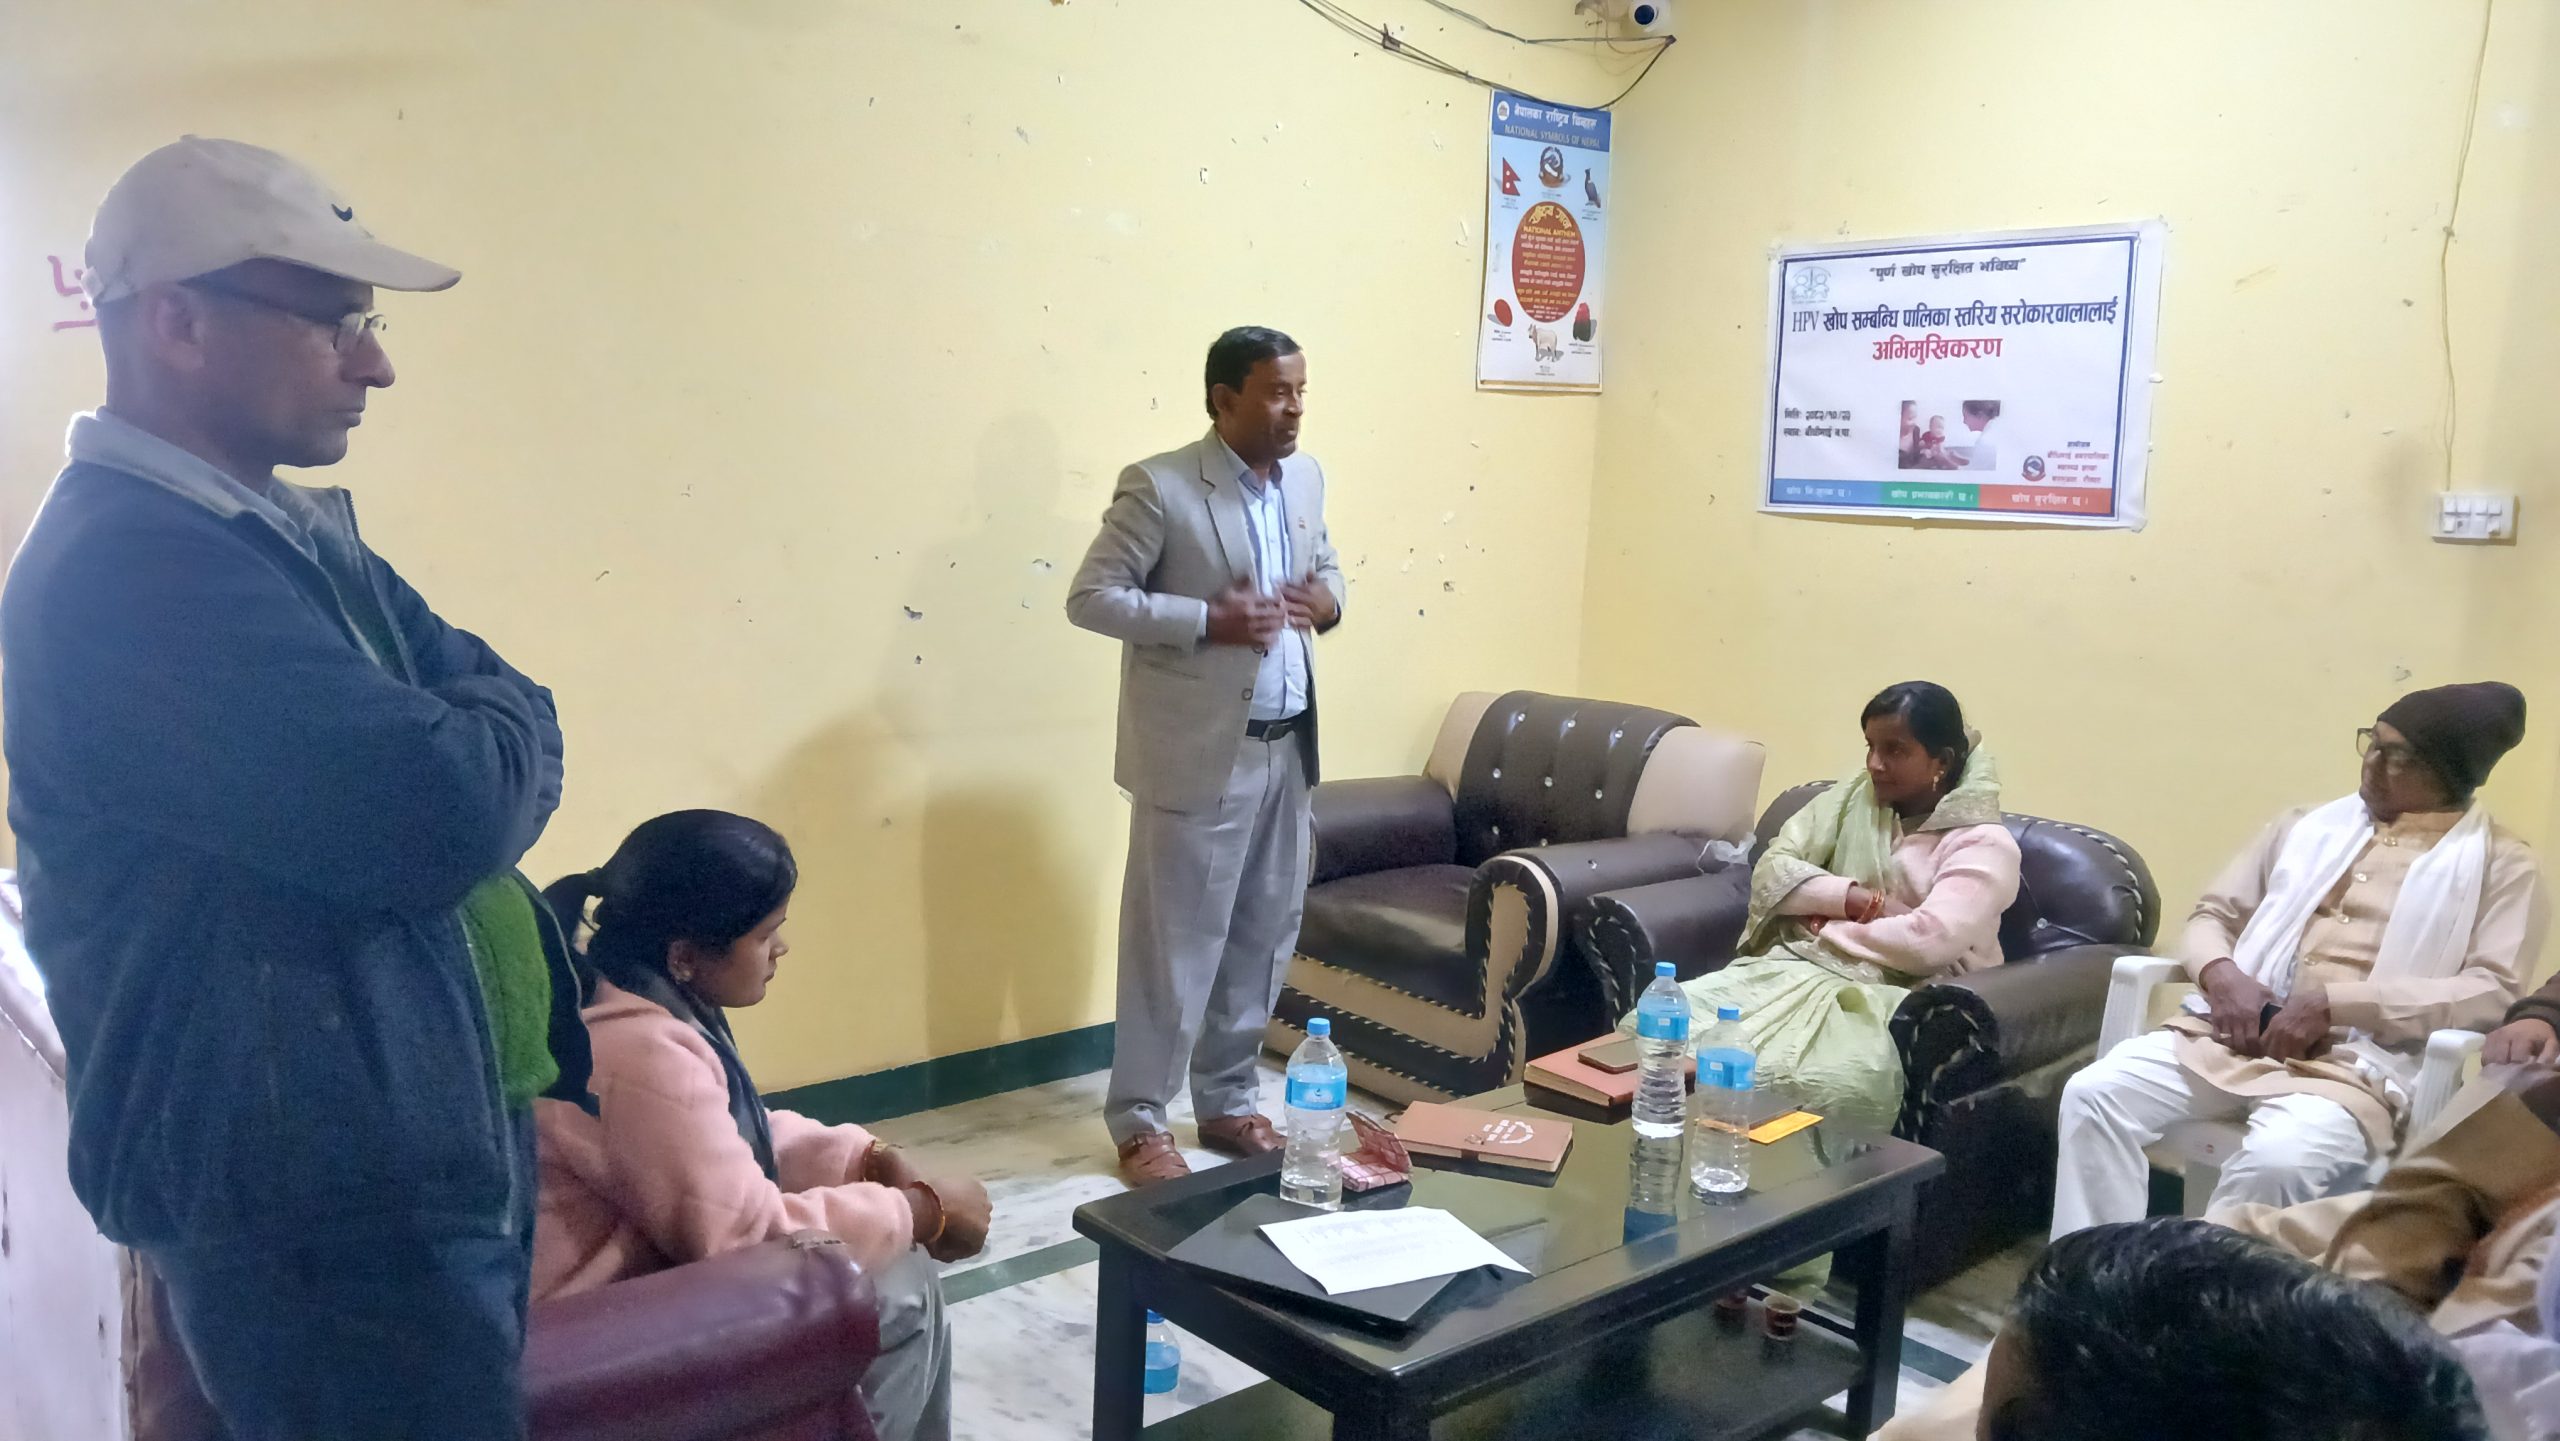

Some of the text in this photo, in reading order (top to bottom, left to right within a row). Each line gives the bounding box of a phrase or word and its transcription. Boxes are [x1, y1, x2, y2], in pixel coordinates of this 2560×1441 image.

[1504, 124, 1538, 139] NATIONAL
[1540, 131, 1570, 144] SYMBOLS
[1572, 134, 1579, 145] OF
[1523, 226, 1576, 238] NATIONAL ANTHEM
[1901, 262, 1926, 277] खोप
[1931, 259, 1974, 280] सुरक्षित
[1792, 310, 1819, 332] HPV
[1823, 306, 1849, 332] खोप
[1903, 302, 1951, 328] पालिका
[1954, 299, 1997, 327] स्तरिय
[2001, 295, 2118, 326] सरोकारवालालाई
[1872, 333, 2004, 366] अभिमुखिकरण
[2011, 492, 2030, 503] खोप
[2034, 492, 2069, 506] सुरक्षित
